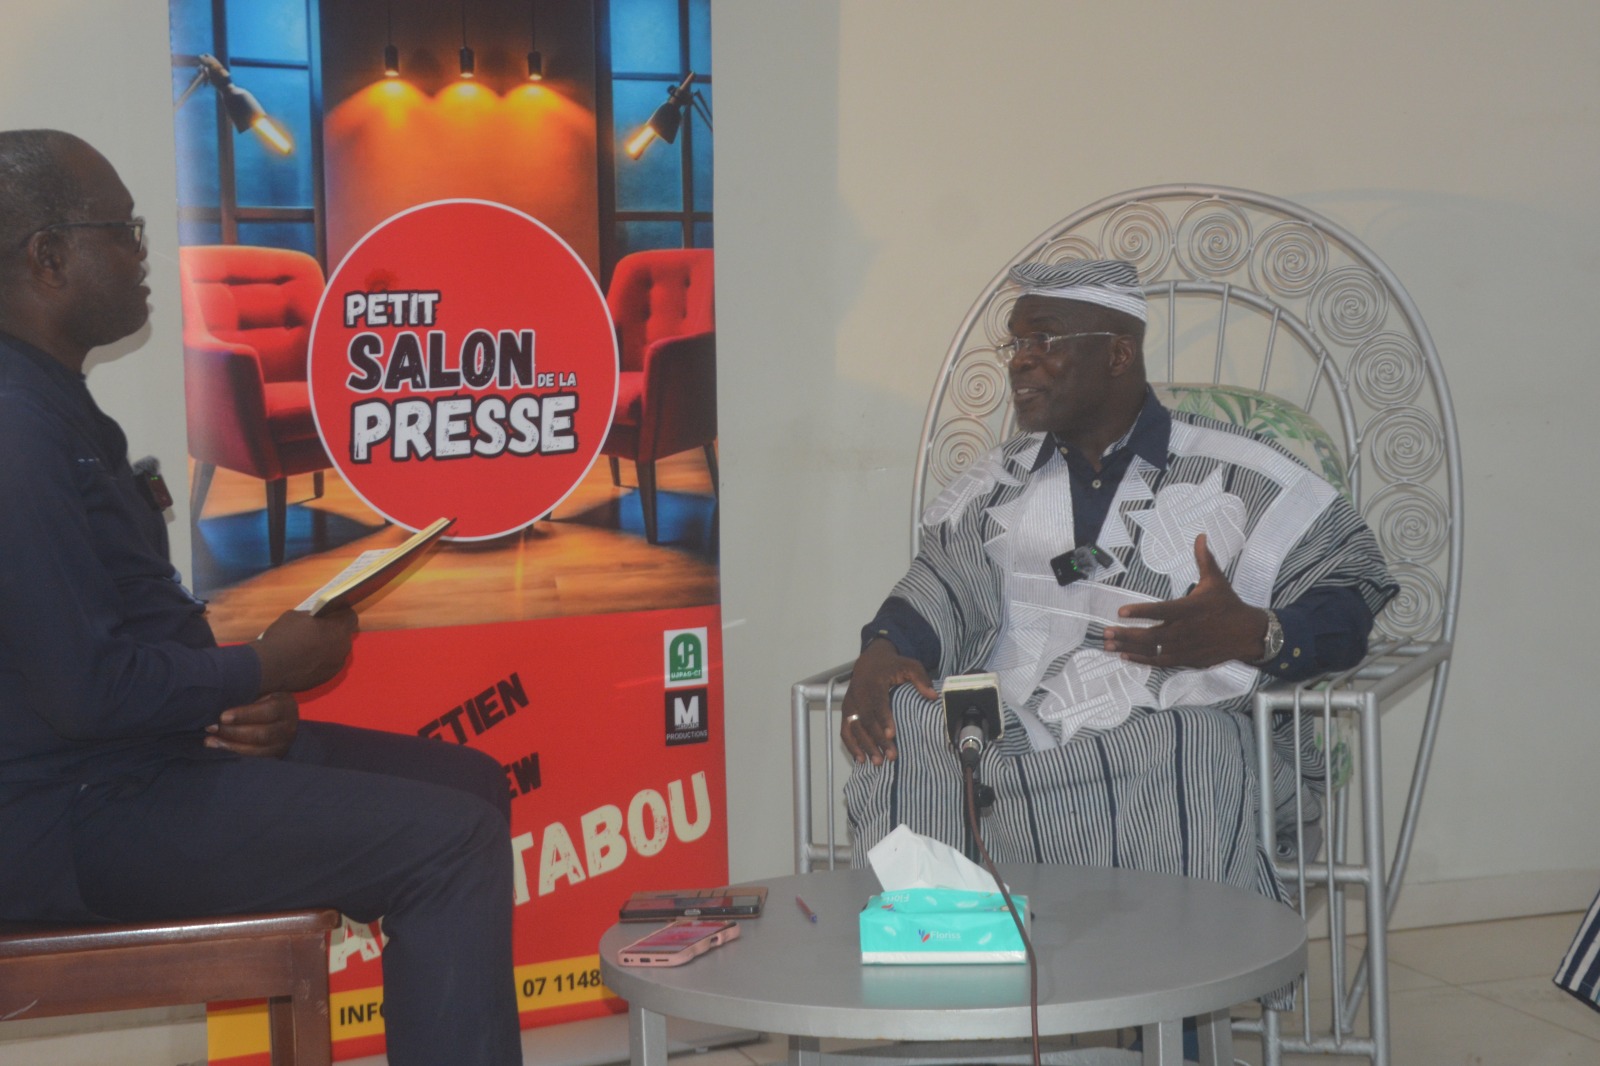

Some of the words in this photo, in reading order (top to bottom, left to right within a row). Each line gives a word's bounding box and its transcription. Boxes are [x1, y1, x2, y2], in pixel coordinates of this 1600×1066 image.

[345, 292, 439, 326] PETIT
[346, 329, 535, 393] SALON
[537, 373, 555, 388] DE
[559, 372, 577, 387] LA
[353, 394, 577, 462] PRESSE
[666, 730, 708, 741] PRODUCTIONS
[328, 913, 390, 974] A
[512, 771, 711, 906] TABOU
[930, 931, 961, 940] Floriss
[522, 976, 548, 998] 07
[554, 969, 604, 993] 1148
